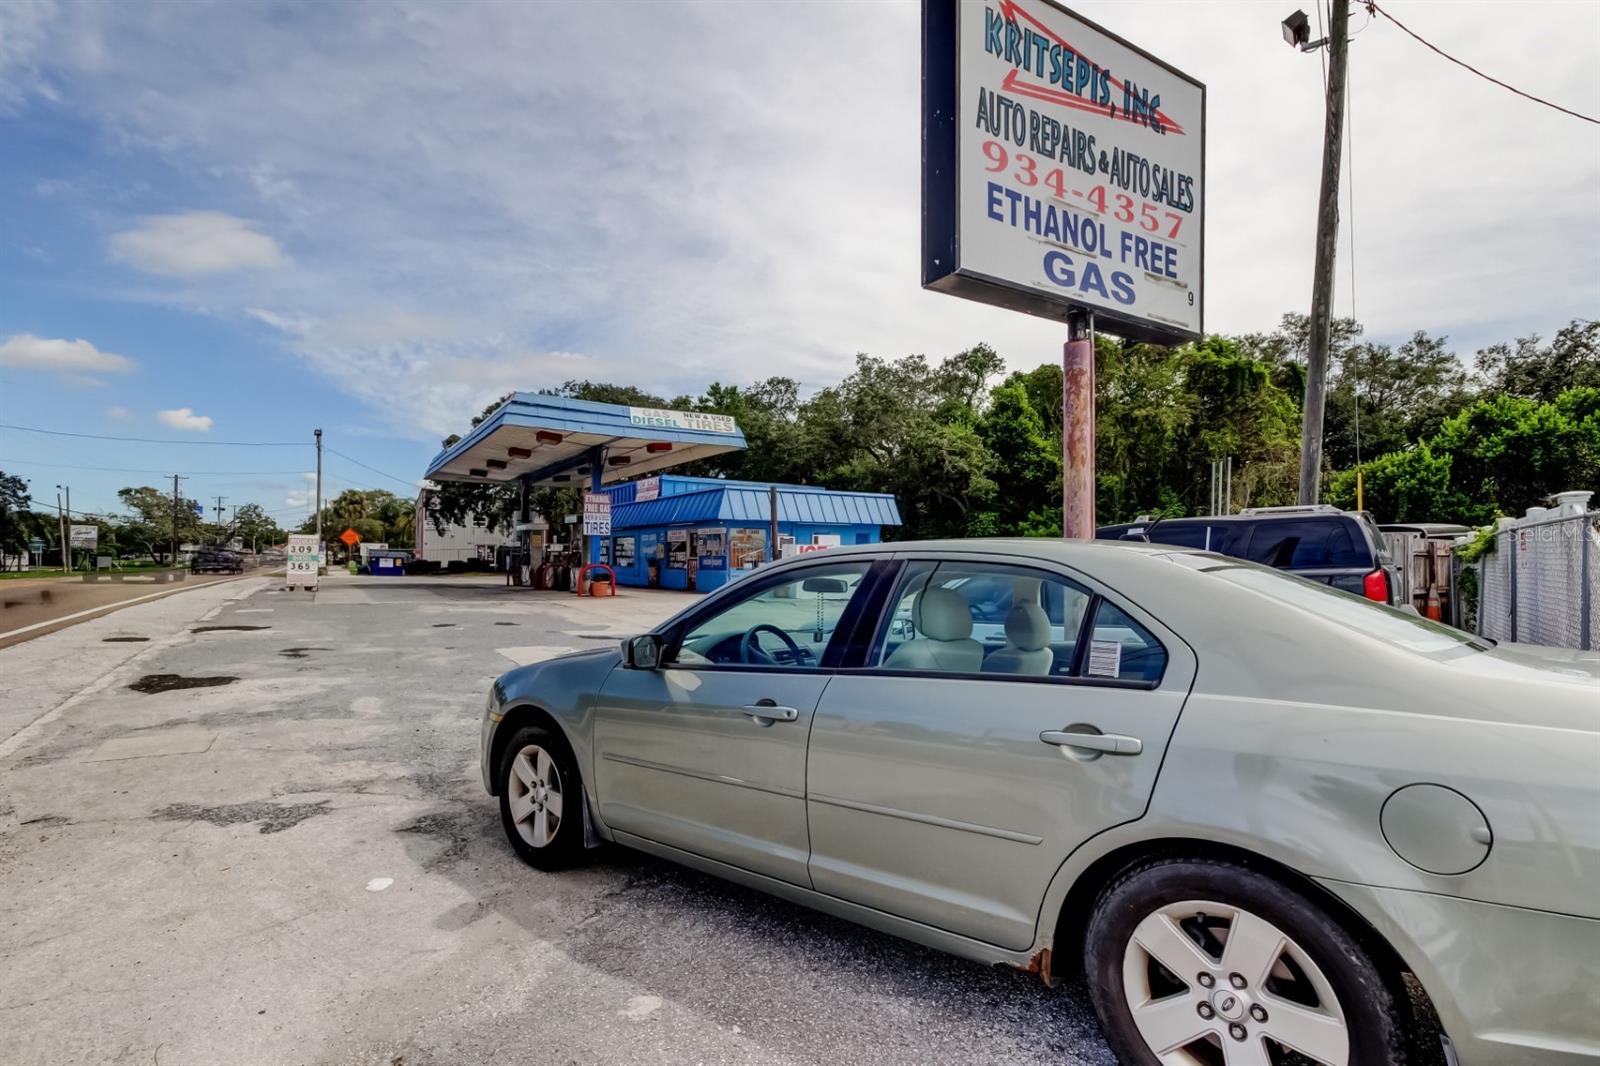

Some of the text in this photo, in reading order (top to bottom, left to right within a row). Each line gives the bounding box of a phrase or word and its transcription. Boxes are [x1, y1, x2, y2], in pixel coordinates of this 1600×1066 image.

[985, 6, 1167, 136] KRITSEPIS, INC.
[976, 87, 1194, 214] AUTO REPAIRS & AUTO SALES
[982, 140, 1184, 240] 934-4357
[987, 181, 1178, 279] ETHANOL FREE
[1043, 250, 1136, 306] GAS
[1188, 291, 1194, 306] 9
[633, 416, 680, 428] DIESEL
[642, 409, 670, 419] GAS
[686, 419, 733, 432] TIRES
[584, 522, 610, 534] TIRES
